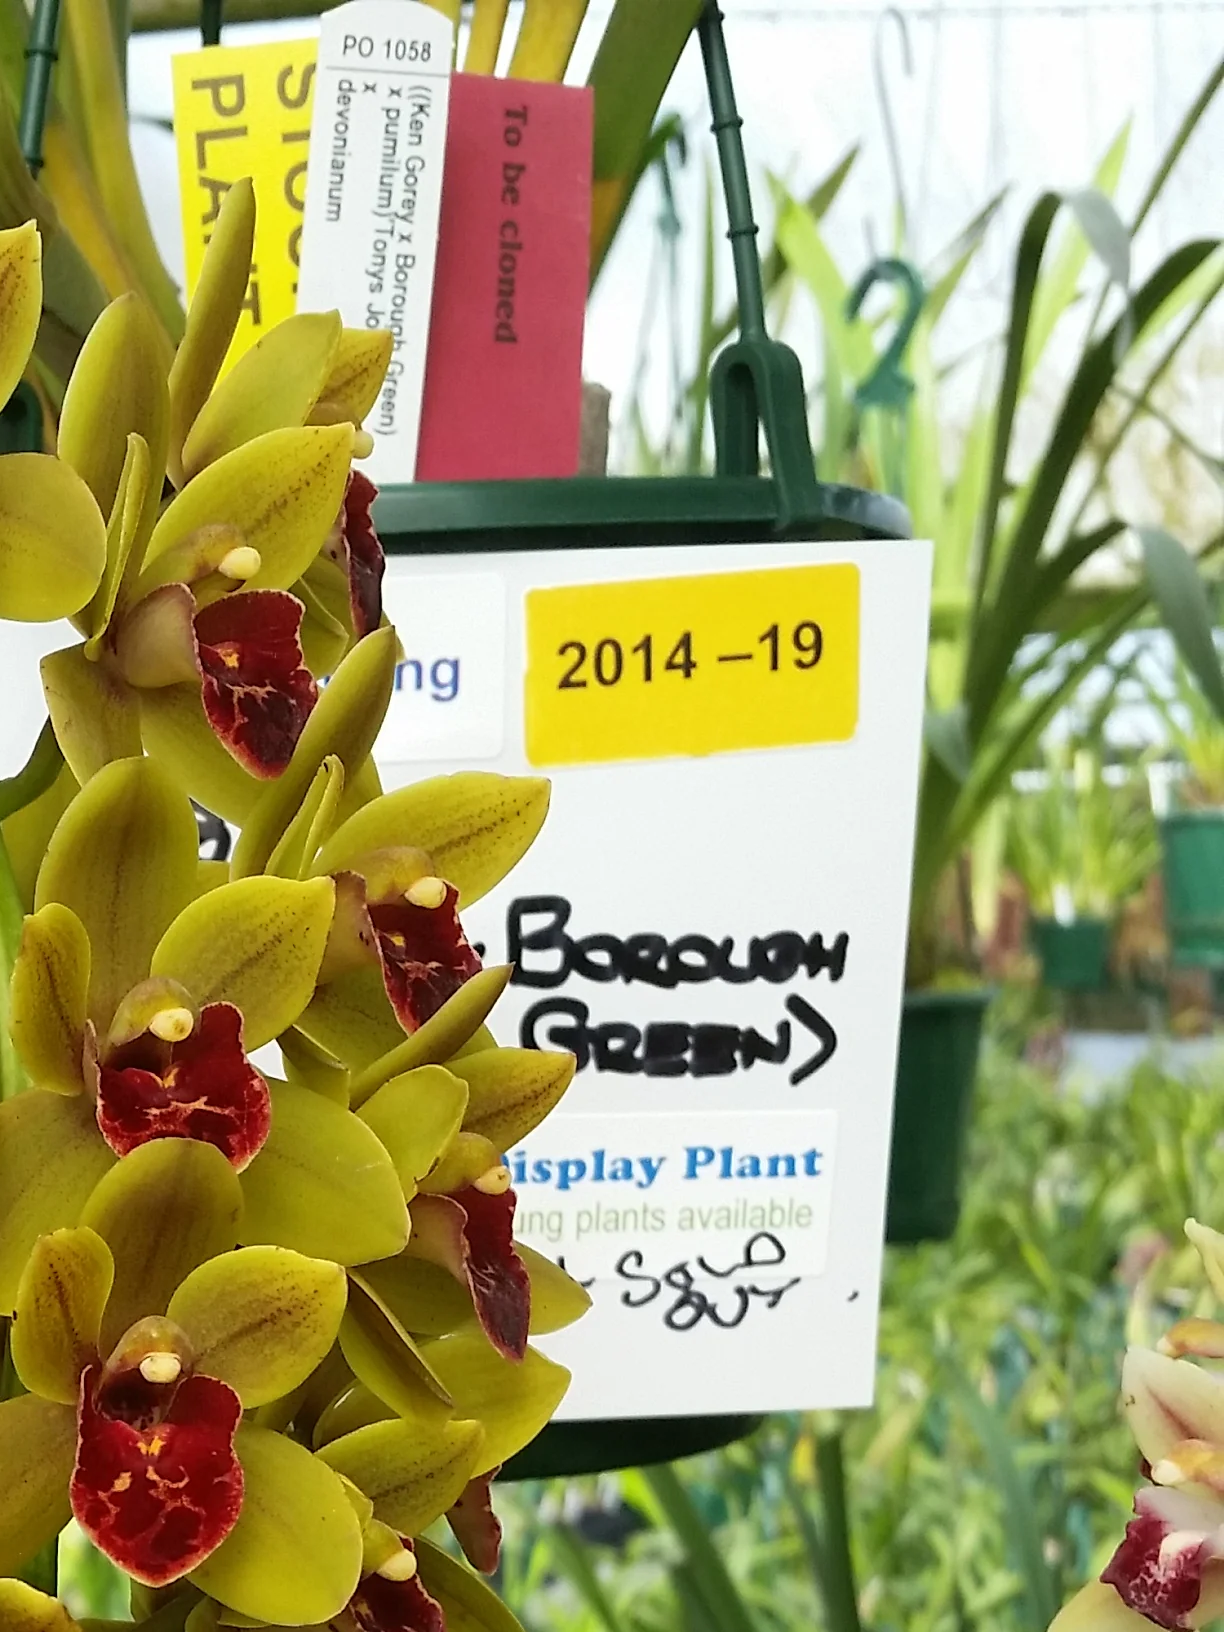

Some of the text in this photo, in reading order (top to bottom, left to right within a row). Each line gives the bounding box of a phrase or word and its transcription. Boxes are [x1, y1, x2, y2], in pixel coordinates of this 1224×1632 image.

[342, 34, 432, 62] PO 1058
[363, 82, 377, 94] x
[388, 87, 402, 98] x
[325, 78, 357, 222] devonianum
[191, 74, 261, 326] PLAT
[394, 155, 426, 224] Gorey
[398, 232, 413, 244] x
[494, 105, 529, 344] To be cloned
[557, 631, 697, 690] 2014
[682, 1145, 823, 1181] Plant
[516, 1197, 814, 1243] ung plants available
